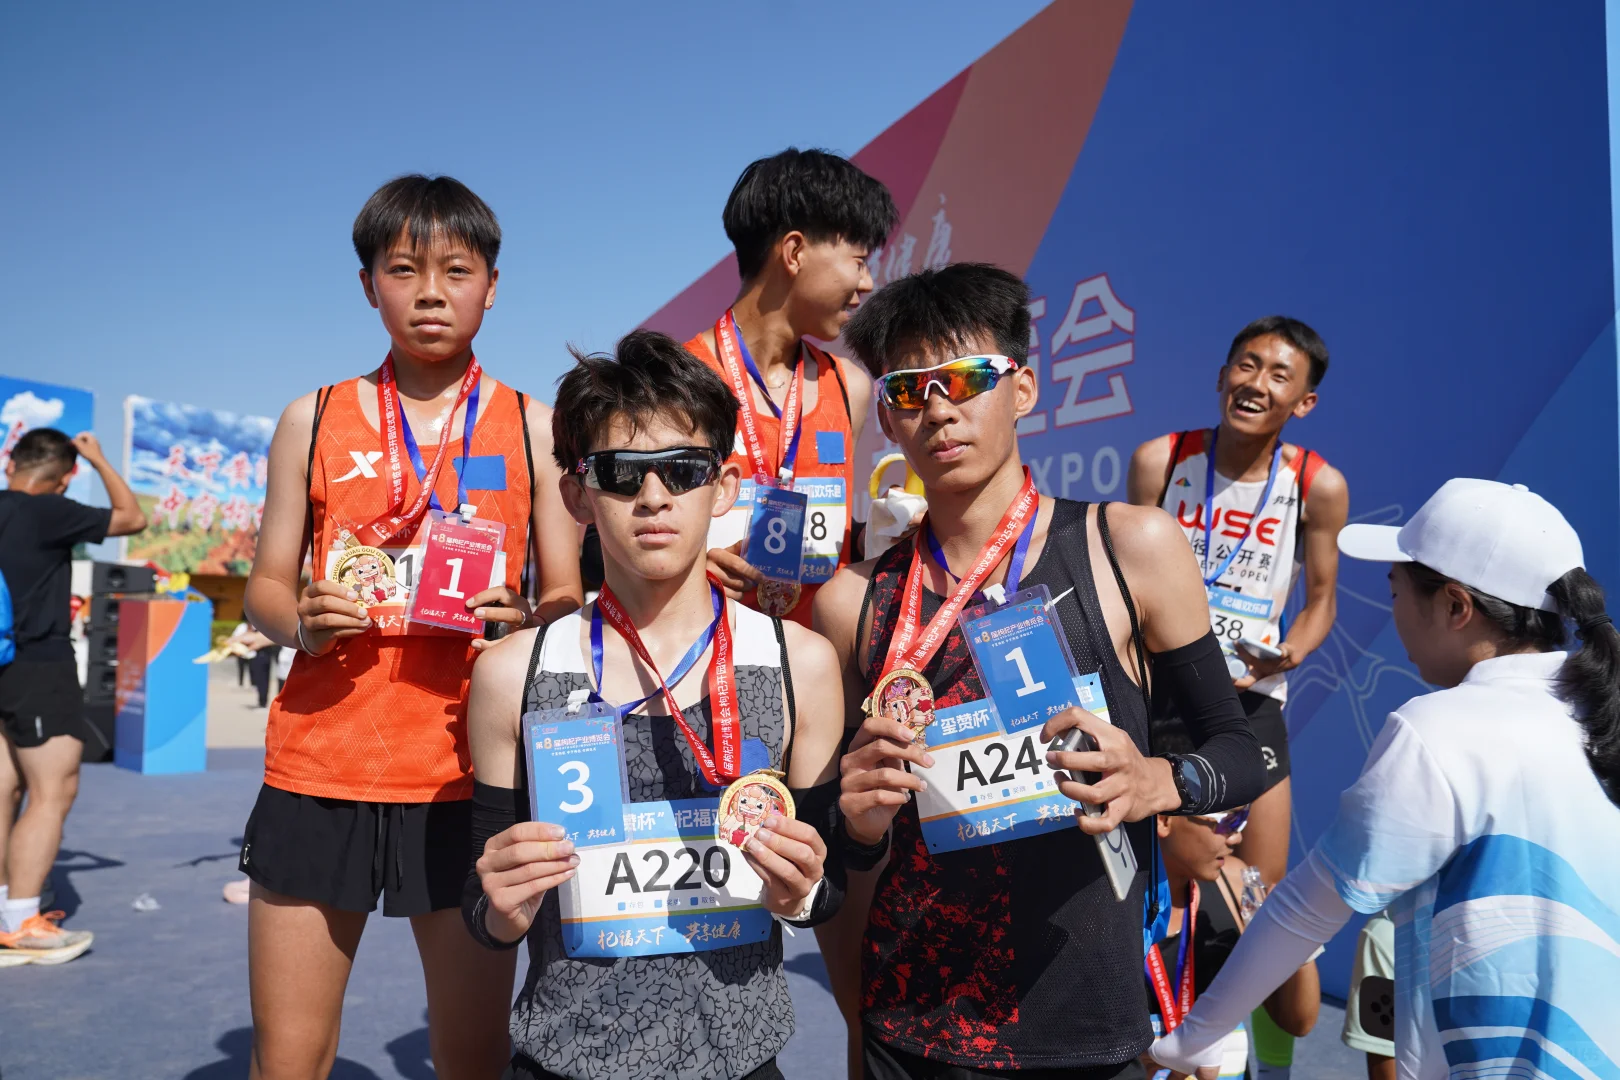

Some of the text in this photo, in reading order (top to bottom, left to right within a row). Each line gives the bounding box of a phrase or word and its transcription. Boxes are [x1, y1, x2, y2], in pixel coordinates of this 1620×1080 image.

[1030, 446, 1120, 498] XPO
[764, 517, 787, 554] 8
[1177, 500, 1281, 546] WSE
[438, 557, 465, 599] 1
[1215, 614, 1244, 640] 38
[1005, 646, 1046, 697] 1
[558, 761, 593, 813] 3
[605, 846, 731, 895] A220
